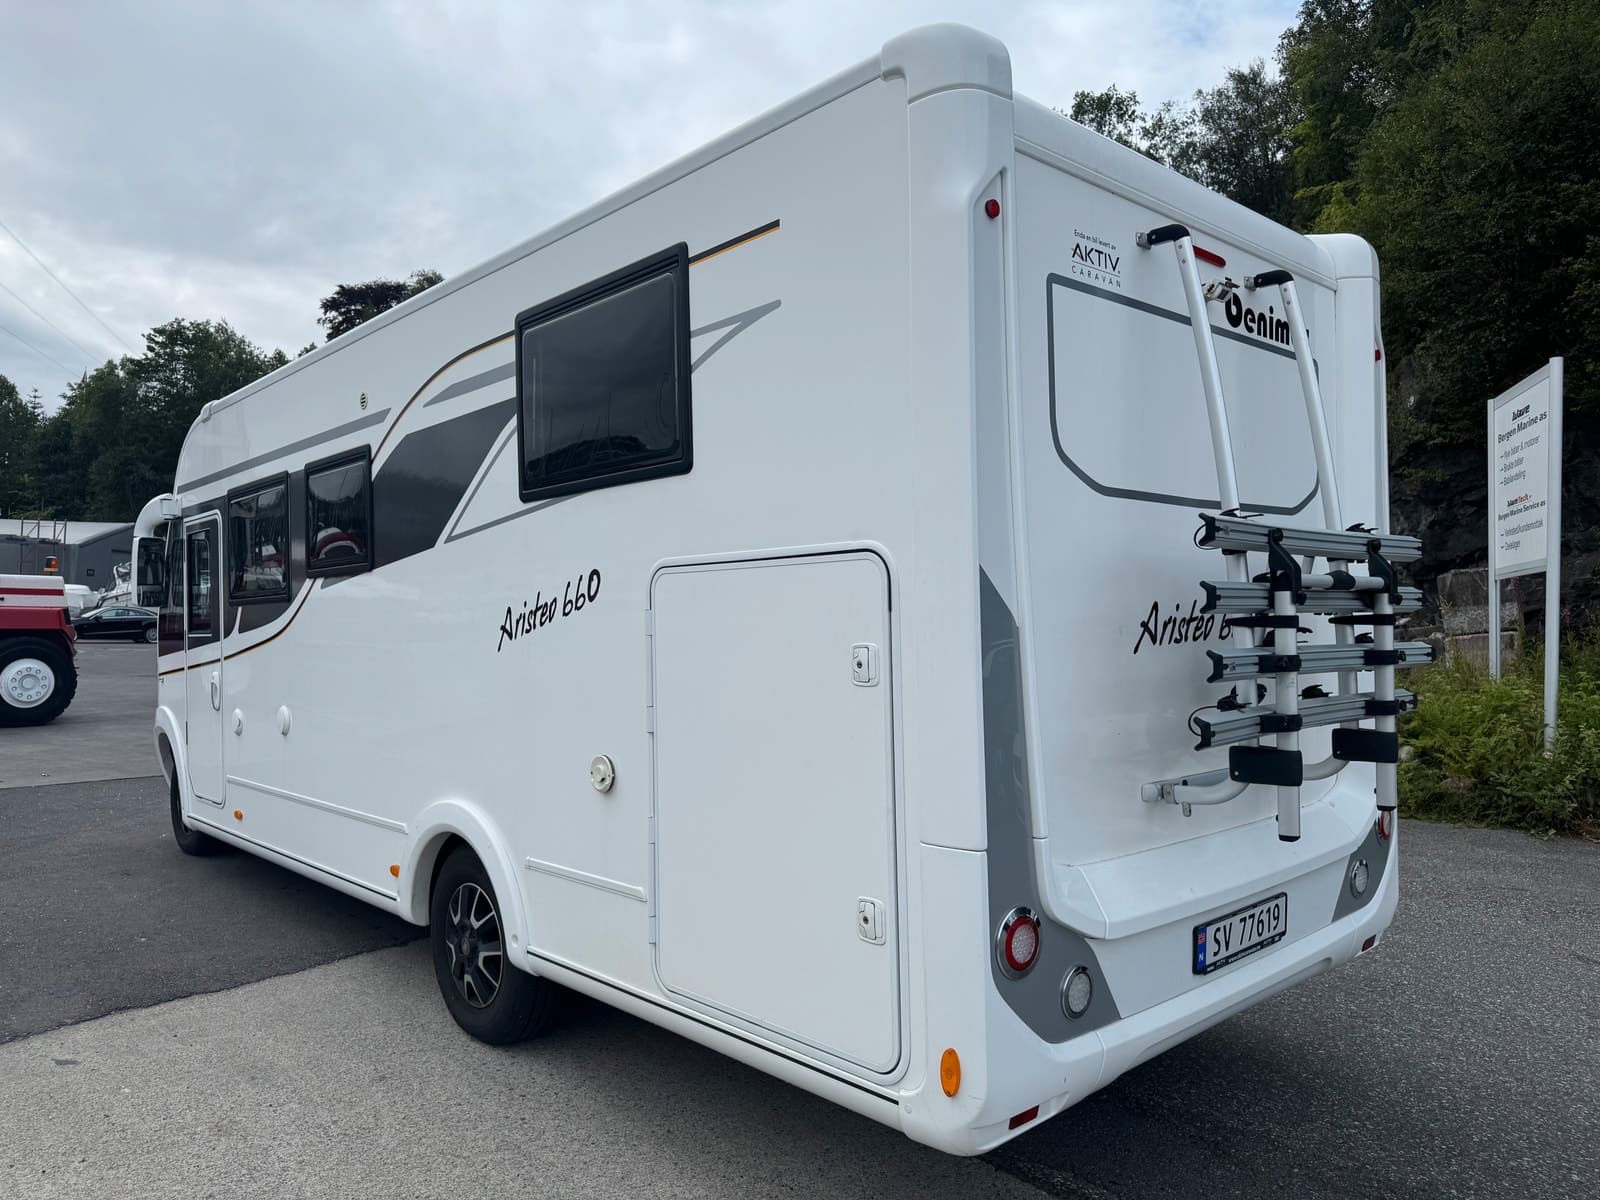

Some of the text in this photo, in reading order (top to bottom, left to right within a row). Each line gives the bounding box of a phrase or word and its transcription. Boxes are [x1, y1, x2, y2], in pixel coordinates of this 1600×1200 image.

[1072, 243, 1120, 272] AKTIV
[1072, 265, 1120, 288] CARAVAN
[1498, 428, 1516, 444] Bergen
[1517, 416, 1539, 433] Marine
[1539, 411, 1548, 422] as
[1523, 501, 1540, 512] Service
[497, 568, 602, 653] Aristeo 660
[1133, 599, 1215, 655] Aristeo
[1212, 922, 1233, 957] SV
[1239, 903, 1280, 946] 77619
